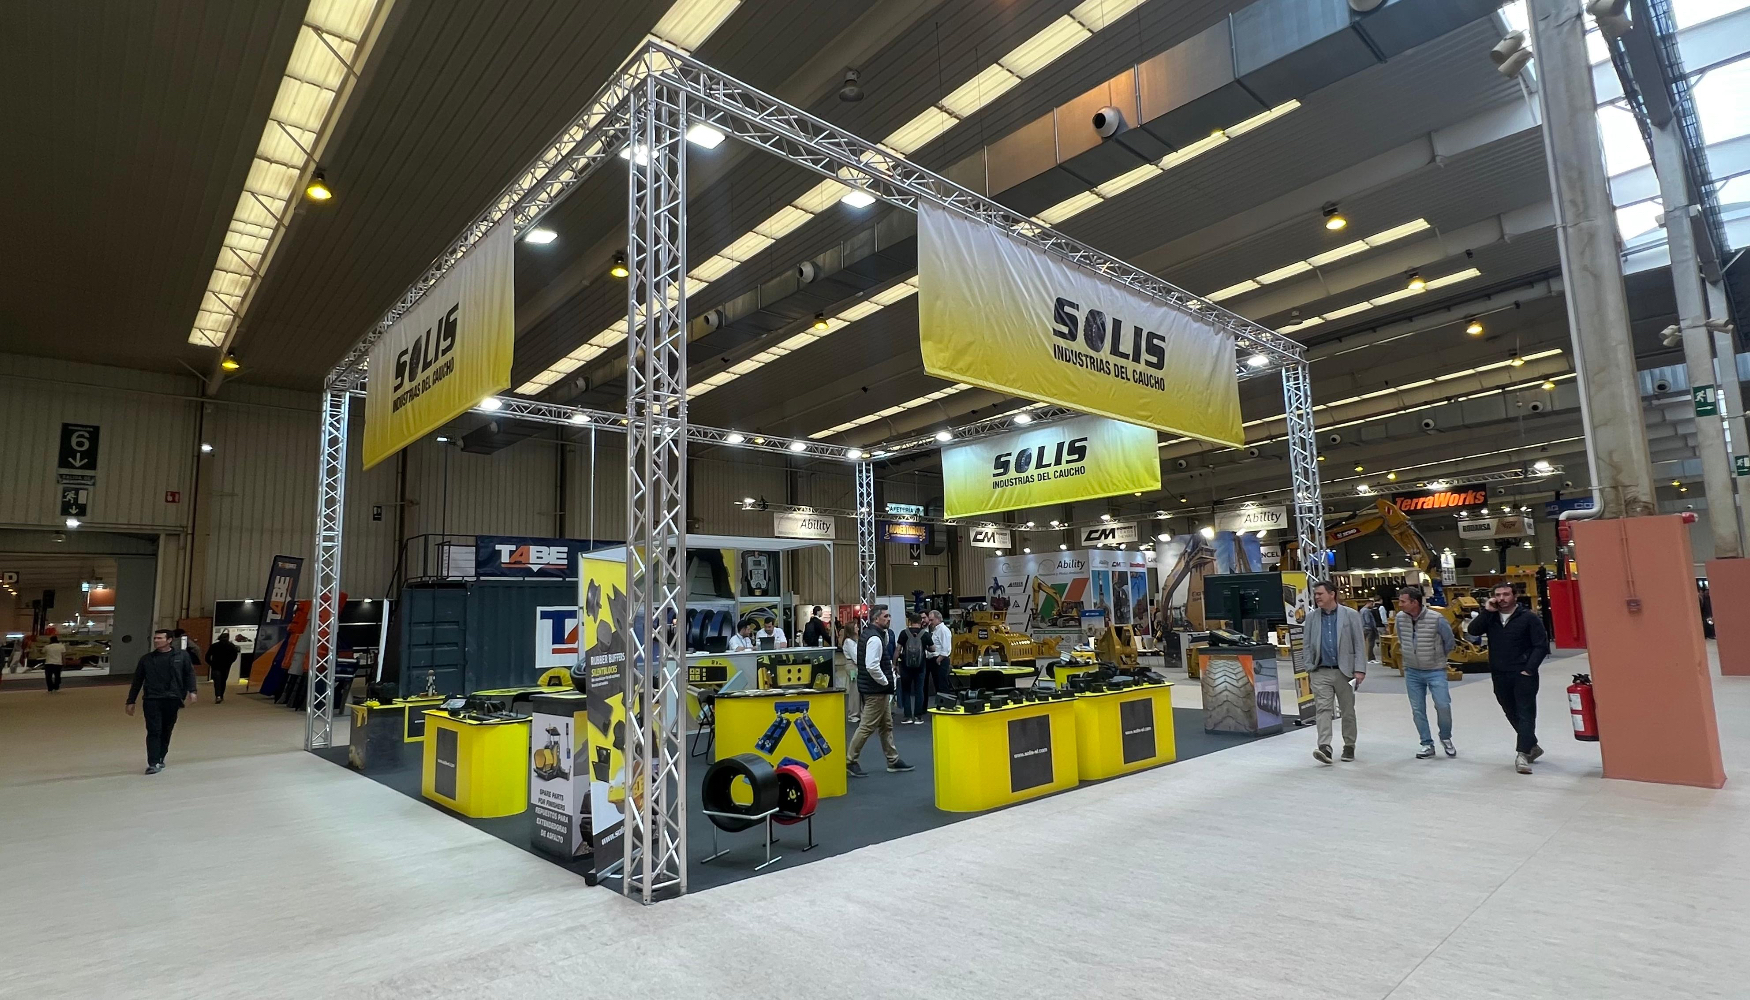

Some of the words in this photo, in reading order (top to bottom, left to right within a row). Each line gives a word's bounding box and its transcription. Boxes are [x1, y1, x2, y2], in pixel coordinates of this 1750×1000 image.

[1052, 297, 1166, 371] SOLIS
[394, 302, 459, 393] SOLIS
[1053, 343, 1111, 375] INDUSTRIAS
[1113, 363, 1131, 382] DEL
[1132, 369, 1165, 392] CAUCHO
[393, 385, 420, 413] INDUSTRIAS
[421, 375, 431, 394] DEL
[432, 357, 454, 386] CAUCHO
[71, 431, 90, 451] 6
[992, 437, 1088, 477] SOLIS
[992, 475, 1035, 489] INDUSTRIAS
[1037, 472, 1051, 481] DEL
[1053, 465, 1086, 478] CAUCHO
[1396, 490, 1486, 511] TerraWorks
[1244, 511, 1282, 523] Ability
[800, 519, 831, 533] Ability
[495, 545, 568, 564] TABE
[1057, 560, 1085, 570] Ability
[1361, 576, 1407, 589] RODARSA
[266, 576, 290, 622] TABE
[591, 655, 608, 665] RUBBER
[608, 652, 625, 663] BUFFERS
[591, 665, 617, 677] SILENTBLOCKS
[539, 789, 551, 798] SPARE
[551, 792, 564, 801] PARTS
[538, 797, 546, 805] FOR
[545, 800, 565, 811] FINISHERS
[535, 806, 557, 820] REPUESTOS
[557, 814, 569, 823] PARA
[536, 817, 567, 834] EXTENDEDORAS
[540, 829, 546, 838] DE
[546, 831, 564, 844] ASFALTO
